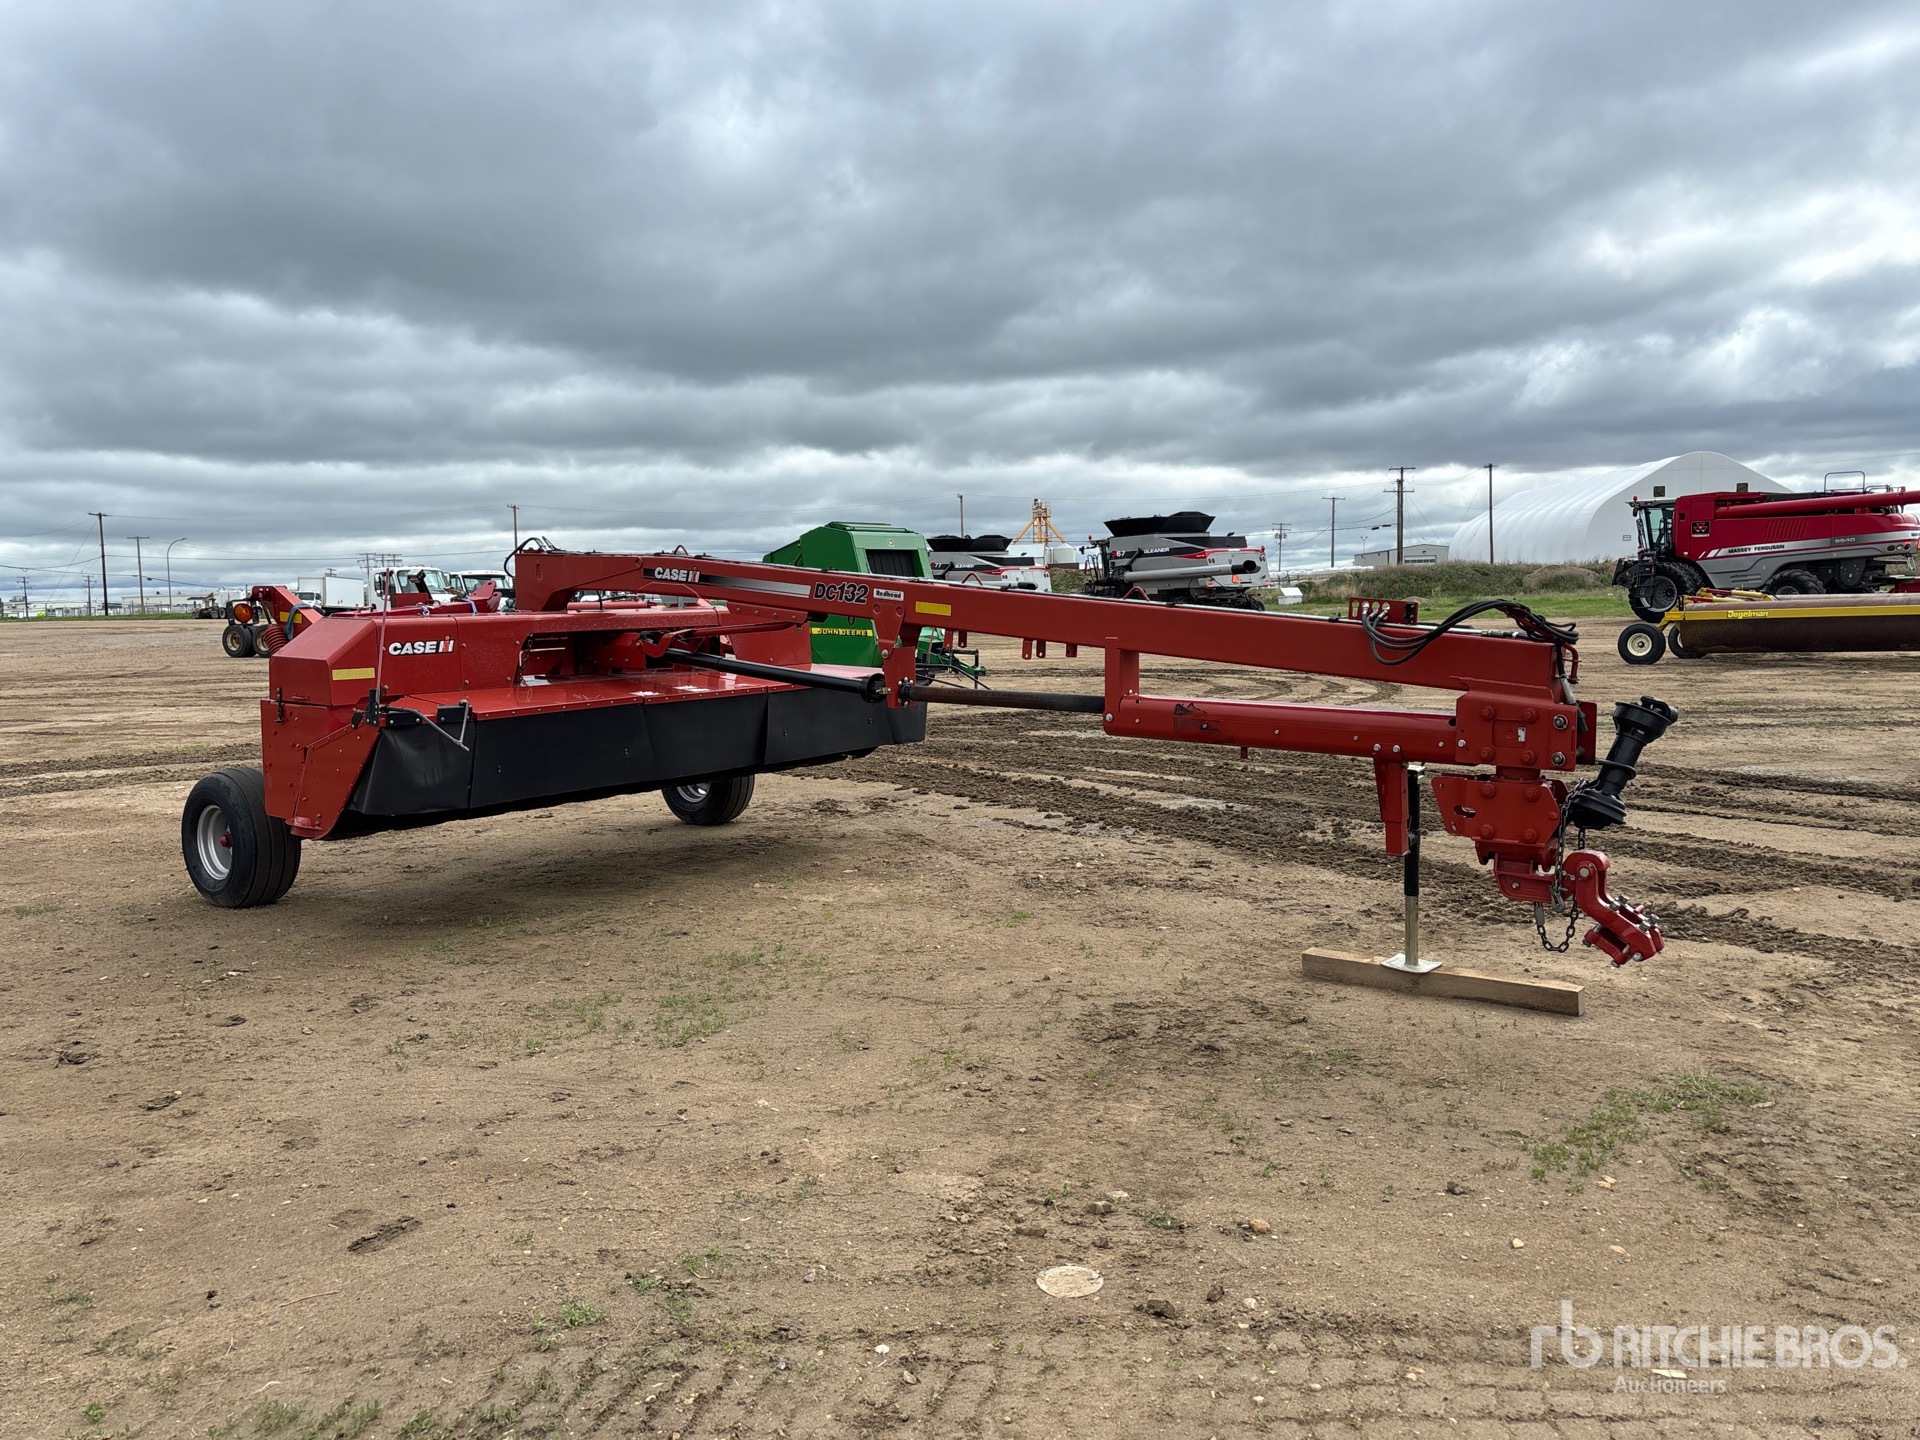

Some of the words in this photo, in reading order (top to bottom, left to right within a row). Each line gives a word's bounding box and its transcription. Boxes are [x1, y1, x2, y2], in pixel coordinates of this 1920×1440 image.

[654, 566, 688, 582] CASE
[813, 582, 870, 605] DC132
[875, 590, 902, 599] Redhead
[1727, 610, 1769, 619] Degelman
[388, 641, 437, 656] CASE
